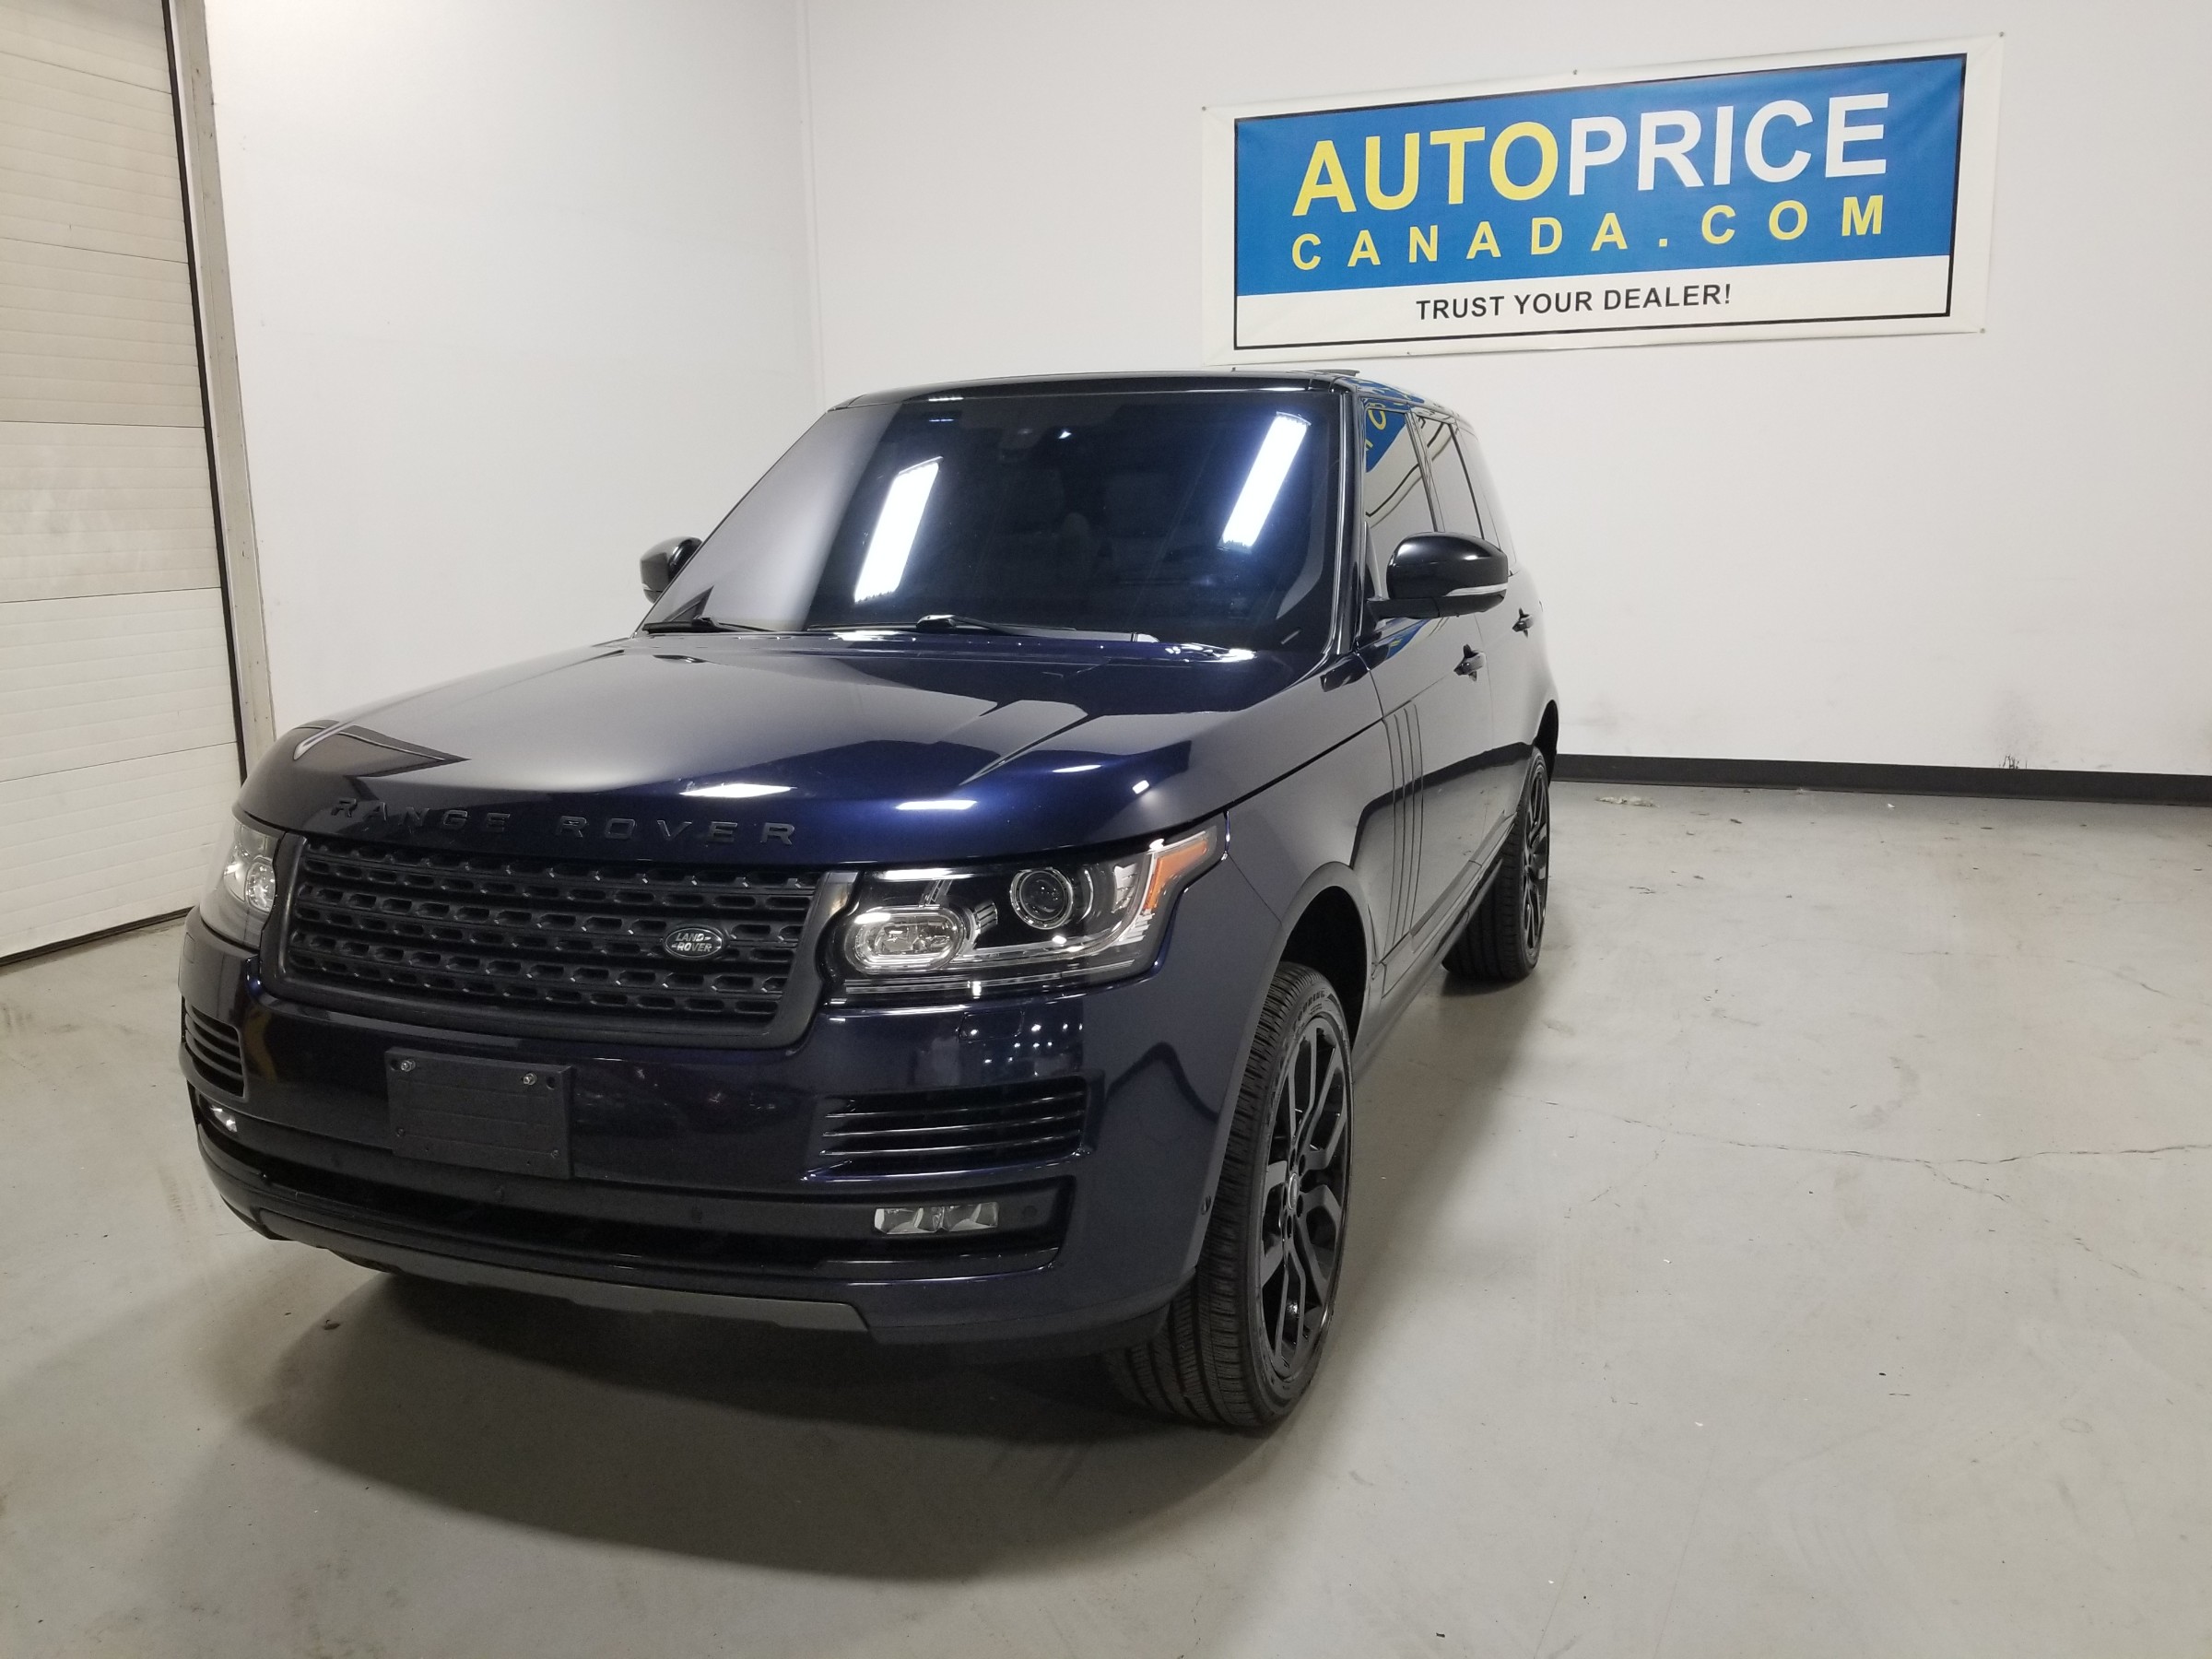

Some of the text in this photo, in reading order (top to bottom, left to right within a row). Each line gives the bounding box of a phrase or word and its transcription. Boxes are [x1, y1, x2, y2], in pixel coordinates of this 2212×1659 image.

[1291, 92, 1889, 217] AUTOPRICE
[1291, 194, 1884, 271] CANADA.COM
[1416, 283, 1732, 320] TRUST YOUR DEALER!
[331, 797, 796, 846] RANGE ROVER
